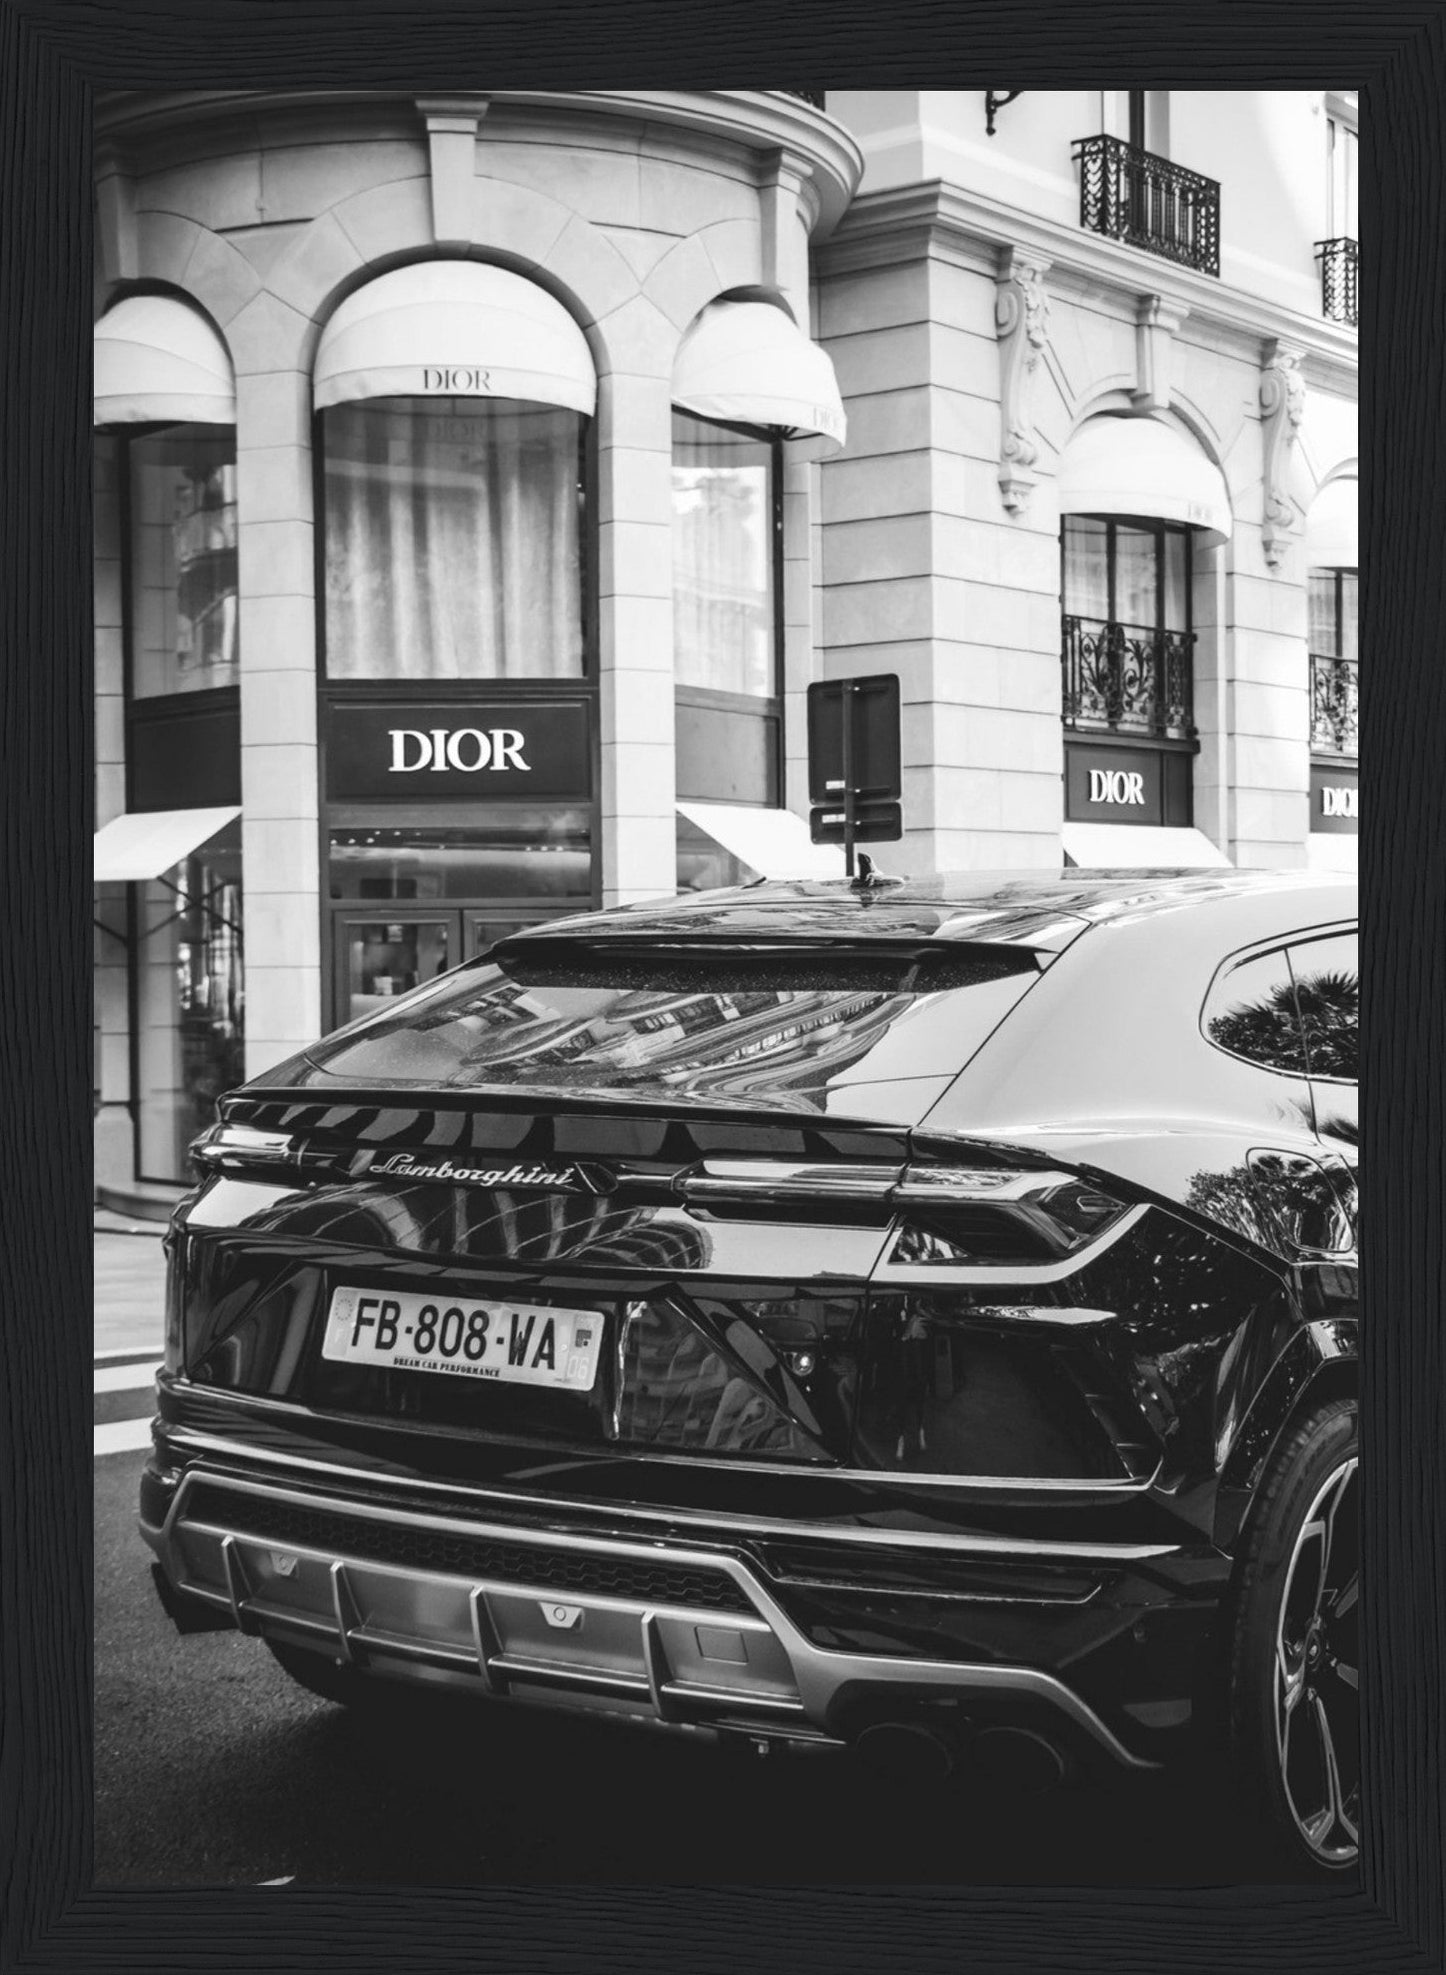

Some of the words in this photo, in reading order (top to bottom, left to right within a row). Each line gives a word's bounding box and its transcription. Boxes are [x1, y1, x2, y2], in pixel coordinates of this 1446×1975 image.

[423, 368, 491, 391] DIOR
[388, 728, 532, 772] DIOR
[1089, 769, 1145, 805] DIOR
[369, 1153, 575, 1187] Lamborghini
[393, 1357, 420, 1368] DREAM
[422, 1360, 438, 1370] CAR
[440, 1363, 500, 1377] PERFORMANCE
